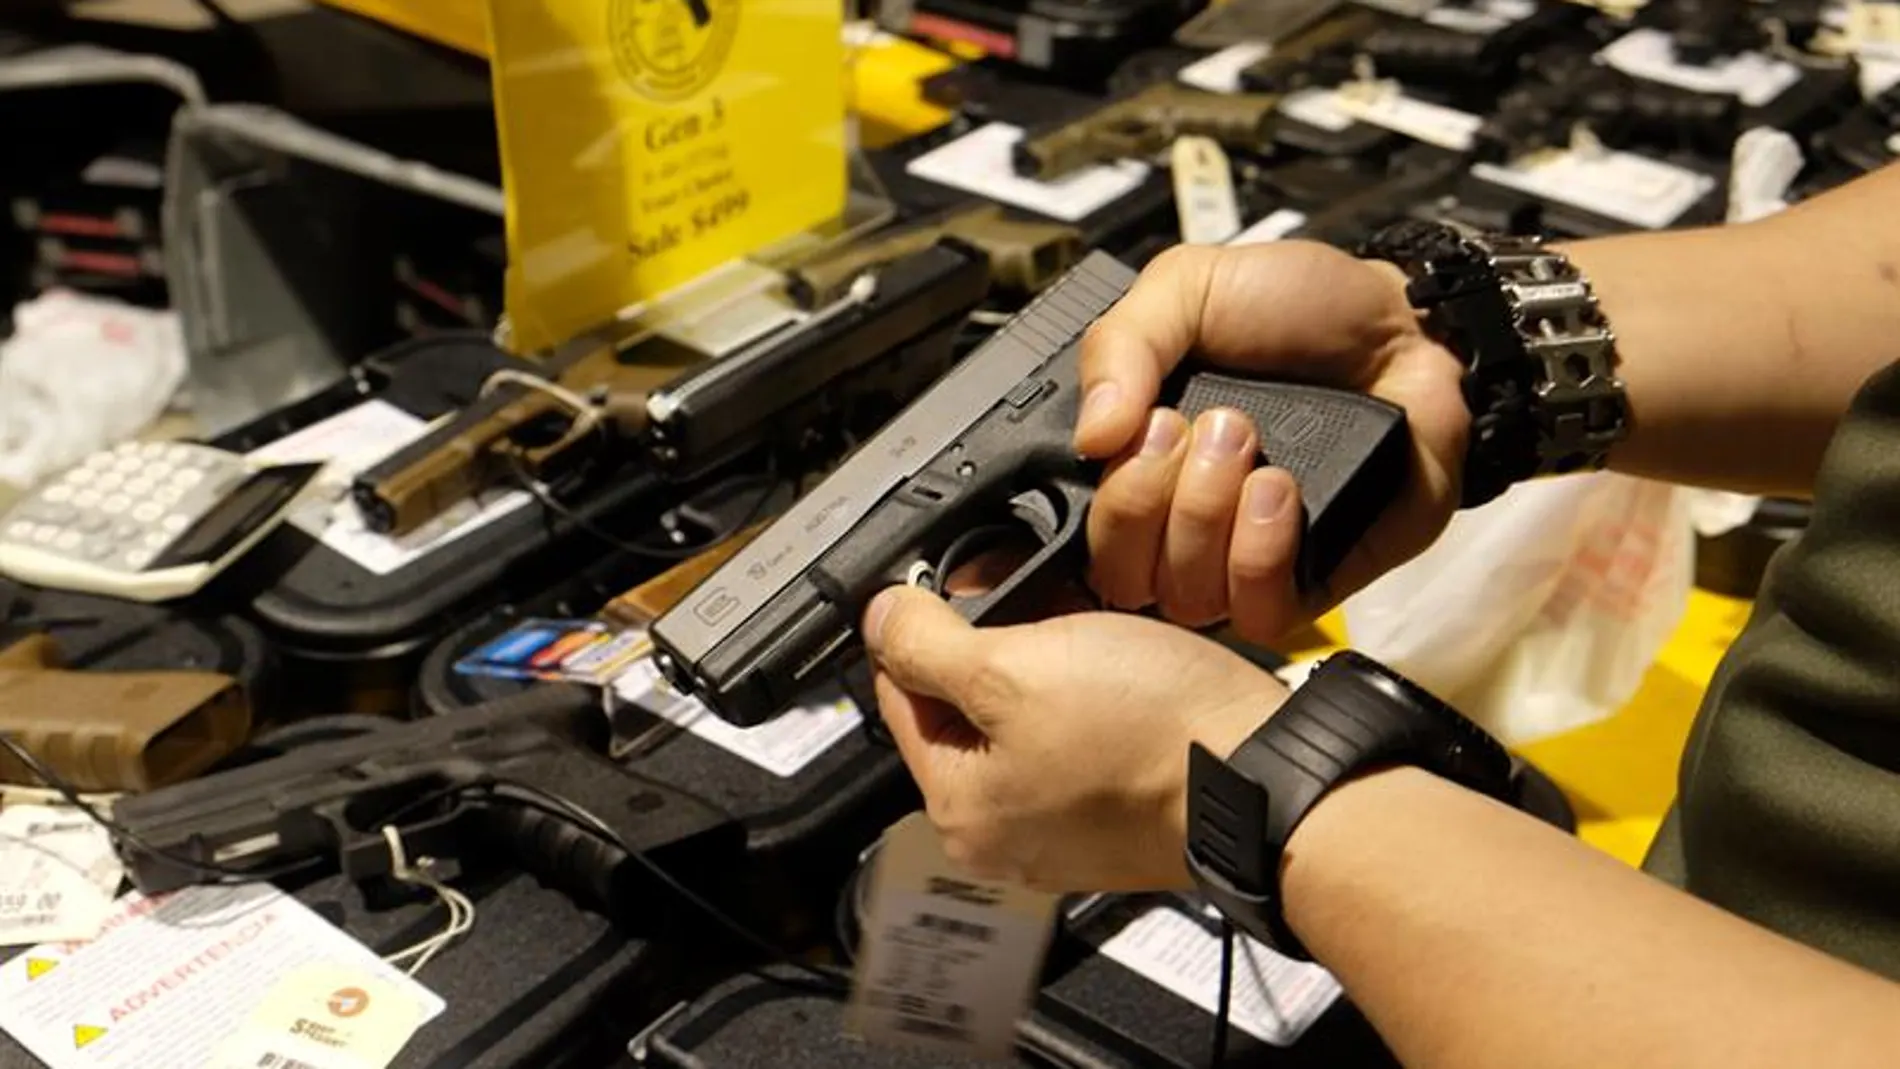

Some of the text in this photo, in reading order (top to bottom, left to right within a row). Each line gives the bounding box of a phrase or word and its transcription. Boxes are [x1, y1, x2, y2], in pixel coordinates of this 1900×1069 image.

[645, 115, 700, 153] Gen
[627, 222, 683, 263] Sale
[110, 912, 278, 1023] ADVERTENCIA
